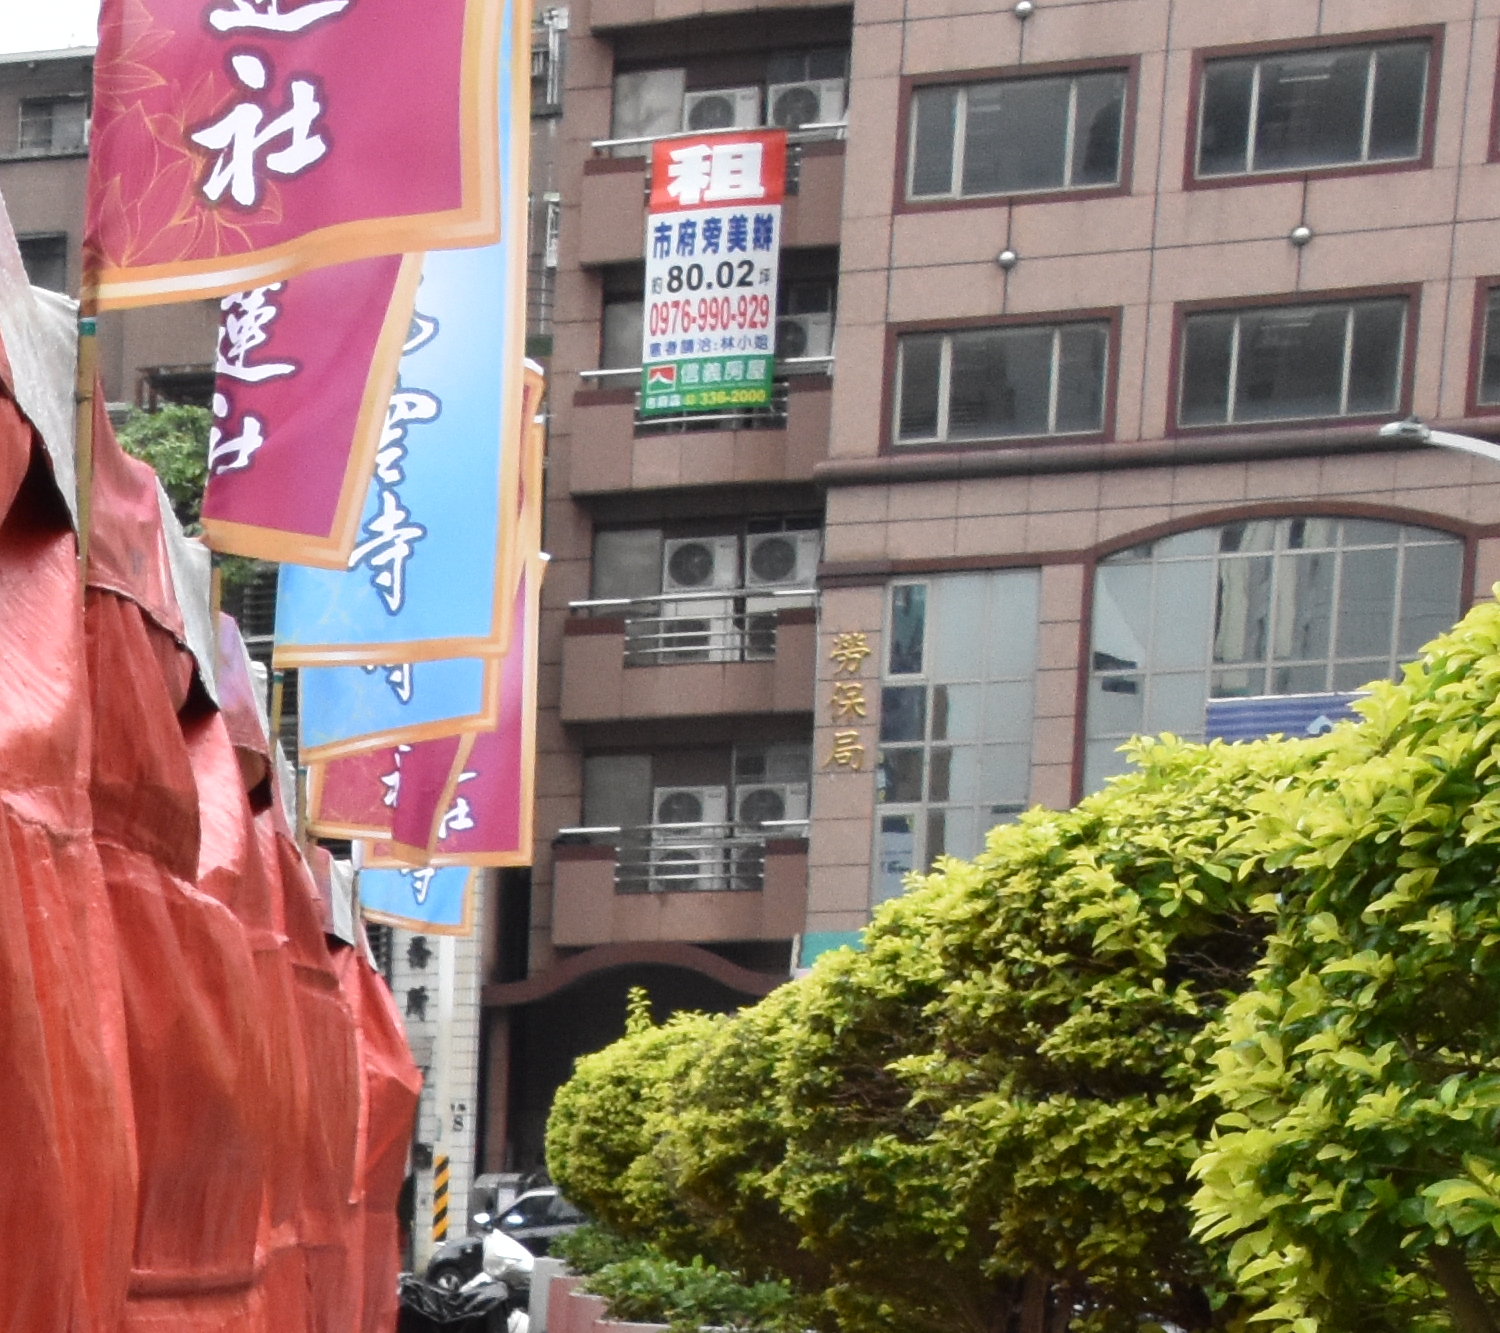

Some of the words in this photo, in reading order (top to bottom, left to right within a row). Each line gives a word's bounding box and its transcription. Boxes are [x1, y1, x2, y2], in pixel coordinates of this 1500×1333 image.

[666, 143, 765, 205] 租
[667, 260, 755, 293] 80.02
[650, 294, 770, 337] 0976-990-929
[822, 632, 872, 771] 勞保局
